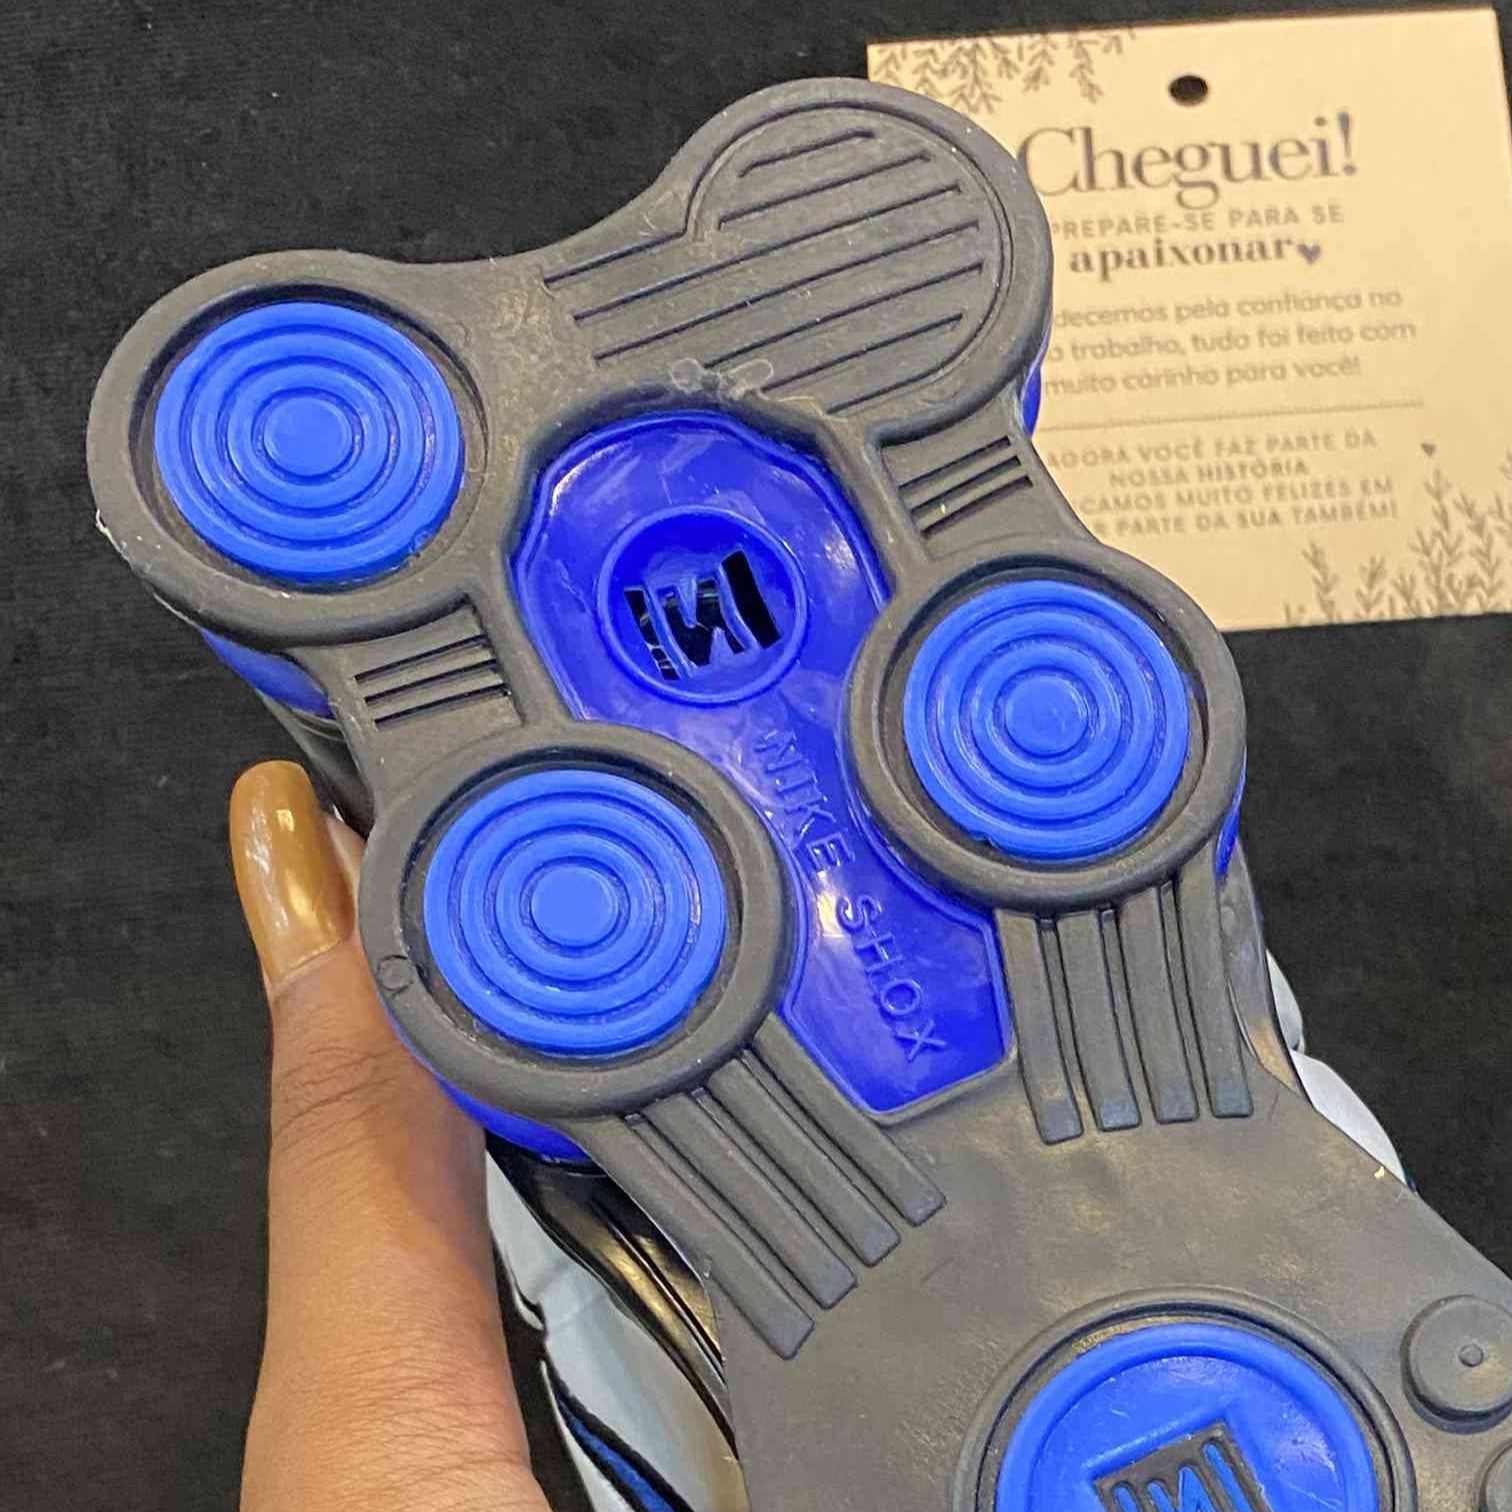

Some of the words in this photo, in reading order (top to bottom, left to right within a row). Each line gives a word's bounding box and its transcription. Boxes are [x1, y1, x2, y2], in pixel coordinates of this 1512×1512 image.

[1016, 112, 1358, 210] Cheguei!
[1229, 207, 1299, 228] PARA
[1312, 204, 1344, 223] SE
[1069, 236, 1298, 282] apaixonar
[1055, 305, 1167, 328] decemos
[1175, 297, 1231, 324] pela
[1237, 287, 1362, 315] confiança
[1191, 328, 1249, 352] tudo
[1258, 322, 1290, 347] foi
[1297, 322, 1353, 344] feito
[1360, 322, 1416, 343] com
[1045, 371, 1116, 394] muito
[1122, 364, 1218, 391] carinho
[1226, 364, 1287, 390] para
[1215, 434, 1257, 456] FAZ
[1265, 431, 1337, 454] PARTE
[1344, 427, 1377, 450] DA
[1108, 466, 1190, 488] NOSSA
[1176, 484, 1252, 508] MUITO
[1262, 478, 1351, 501] FELIZES
[1360, 475, 1393, 496] EM
[1116, 515, 1185, 537] PARTE
[1195, 511, 1230, 532] DA
[1236, 508, 1282, 529] SUA
[753, 728, 856, 872] NIKE
[835, 892, 948, 1063] SHOX
